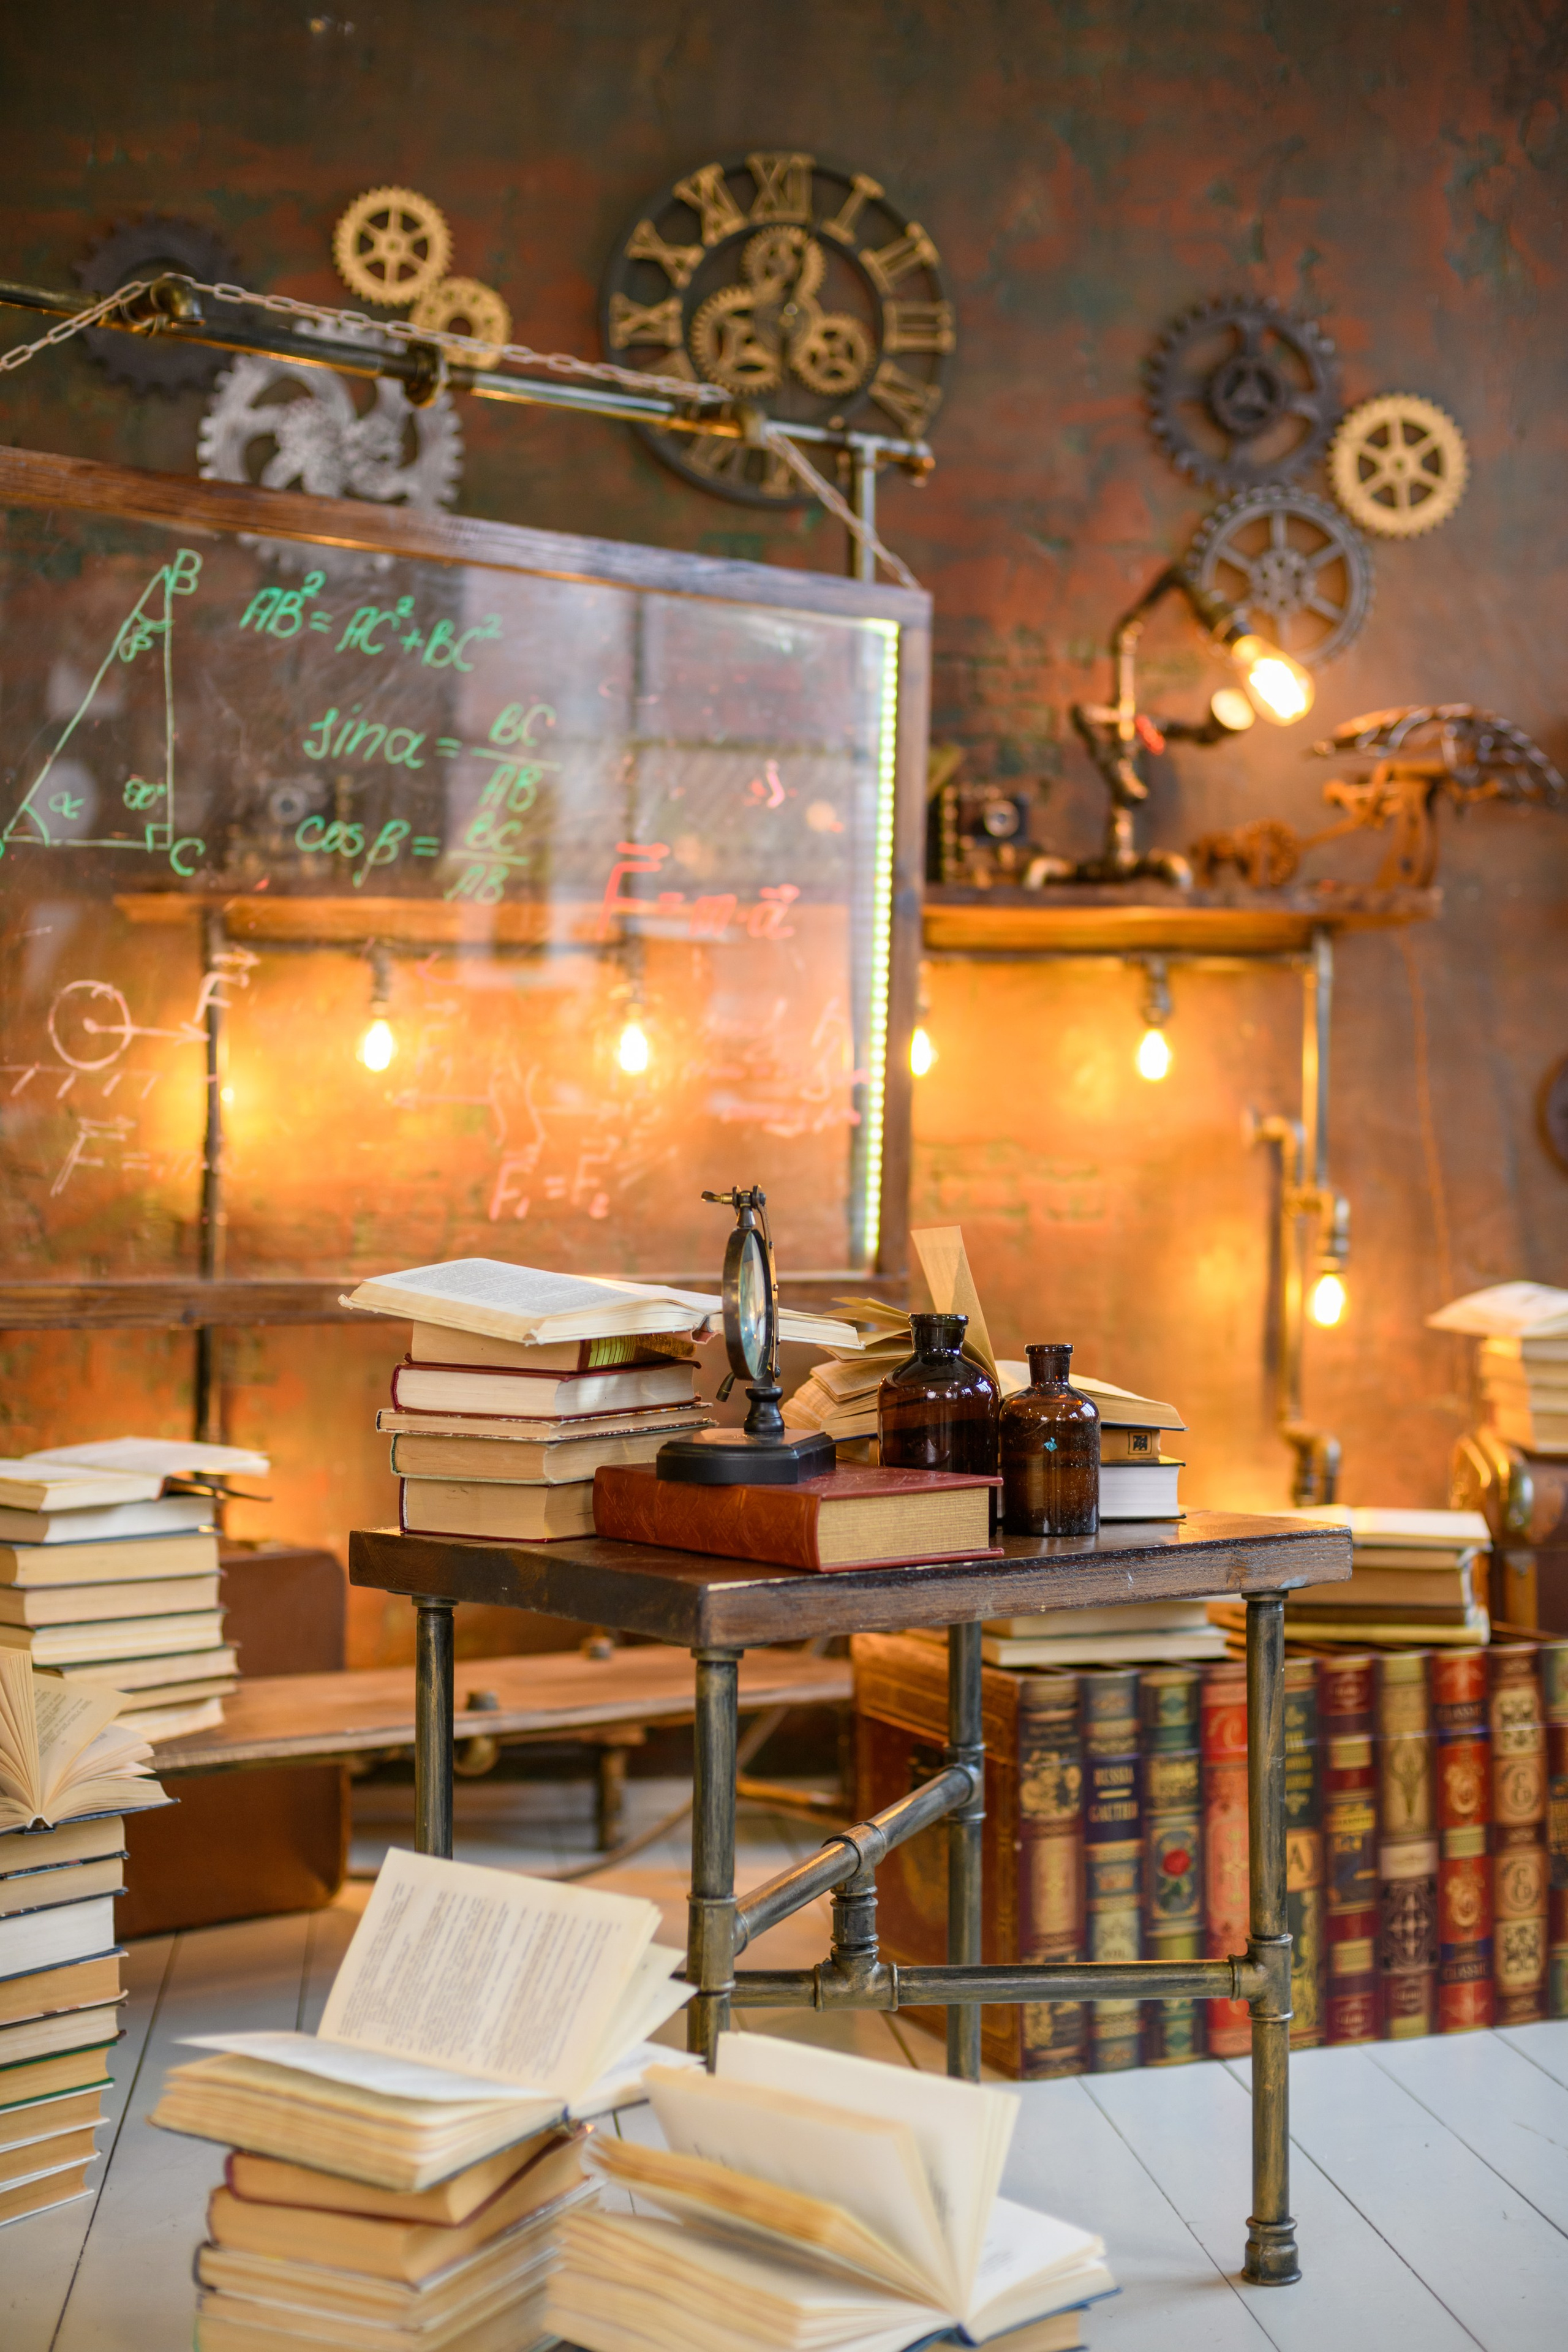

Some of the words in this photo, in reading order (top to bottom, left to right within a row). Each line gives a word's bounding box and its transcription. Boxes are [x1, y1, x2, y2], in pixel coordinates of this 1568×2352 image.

[673, 162, 748, 246] XI
[745, 153, 816, 224] XII
[821, 172, 886, 244] I
[625, 219, 705, 288] X
[859, 221, 940, 292] II
[609, 292, 684, 349] IX
[883, 300, 956, 355] III
[170, 547, 204, 596] B
[170, 837, 206, 877] C
